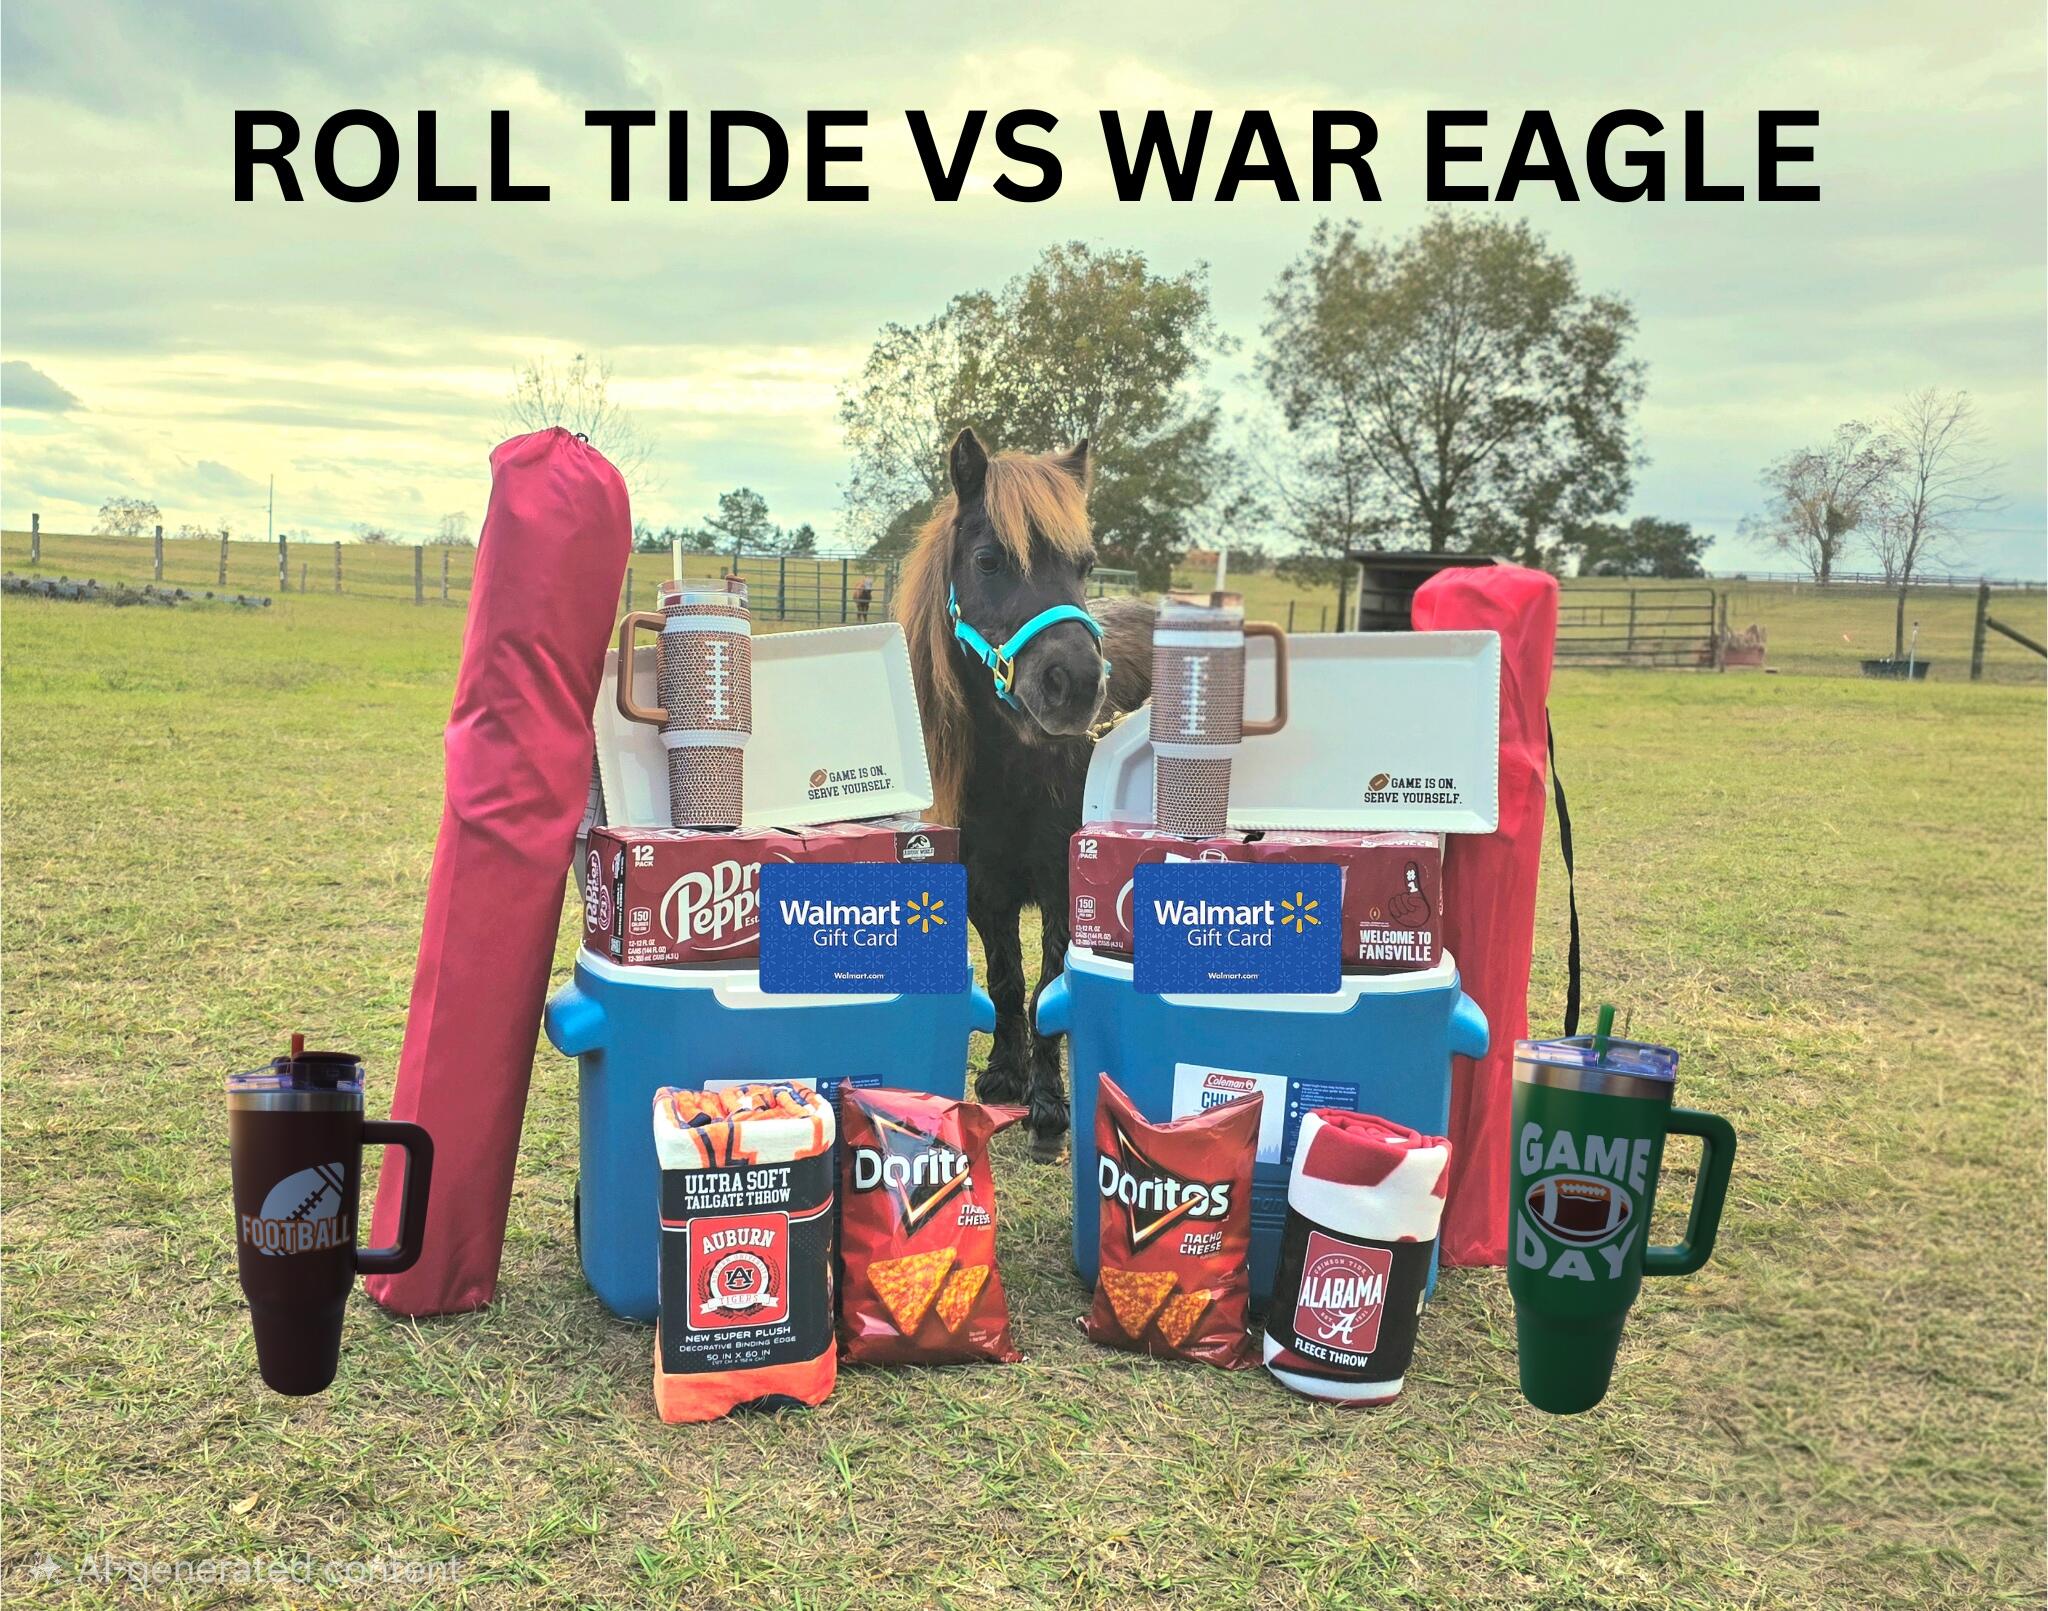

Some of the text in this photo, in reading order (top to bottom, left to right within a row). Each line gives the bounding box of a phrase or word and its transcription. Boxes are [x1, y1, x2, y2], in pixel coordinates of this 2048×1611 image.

[829, 765, 887, 783] GAME IS ON.
[808, 779, 895, 800] SERVE YOURSELF.
[1391, 778, 1457, 790] GAME IS ON.
[1363, 792, 1462, 805] SERVE YOURSELF.
[631, 844, 654, 861] 12
[1078, 839, 1098, 854] 12
[711, 860, 761, 904] Dr
[660, 871, 760, 944] Pepp
[780, 899, 900, 926] Walmart
[1079, 899, 1094, 909] 150
[1154, 900, 1275, 926] Walmart
[632, 910, 649, 921] 150
[813, 928, 898, 947] Gift Card
[1187, 928, 1272, 947] Gift Card
[1359, 930, 1432, 945] WELCOME TO
[1359, 944, 1432, 962] FANSVILLE
[833, 971, 885, 980] Walmart.com
[1207, 971, 1259, 980] Walmart.com
[1207, 1074, 1246, 1089] Coleman
[1520, 1121, 1652, 1196] GAME
[685, 1167, 791, 1195] ULTRA SOFT
[1098, 1154, 1230, 1217] Doritos
[684, 1188, 791, 1211] TAILGATE THROW
[241, 1214, 351, 1251] FOOTBALL
[702, 1227, 776, 1255] AUBURN
[1183, 1231, 1223, 1244] NACHO
[1179, 1241, 1222, 1255] CHEESE
[1516, 1208, 1640, 1282] DAY
[719, 1294, 758, 1305] TIGERS
[1299, 1273, 1383, 1309] ALABAMA
[685, 1325, 791, 1343] NEW SUPER PLUSH
[706, 1353, 719, 1361] 50
[722, 1352, 732, 1360] IN
[745, 1350, 758, 1358] 60
[1294, 1337, 1369, 1368] FLEECE THROW
